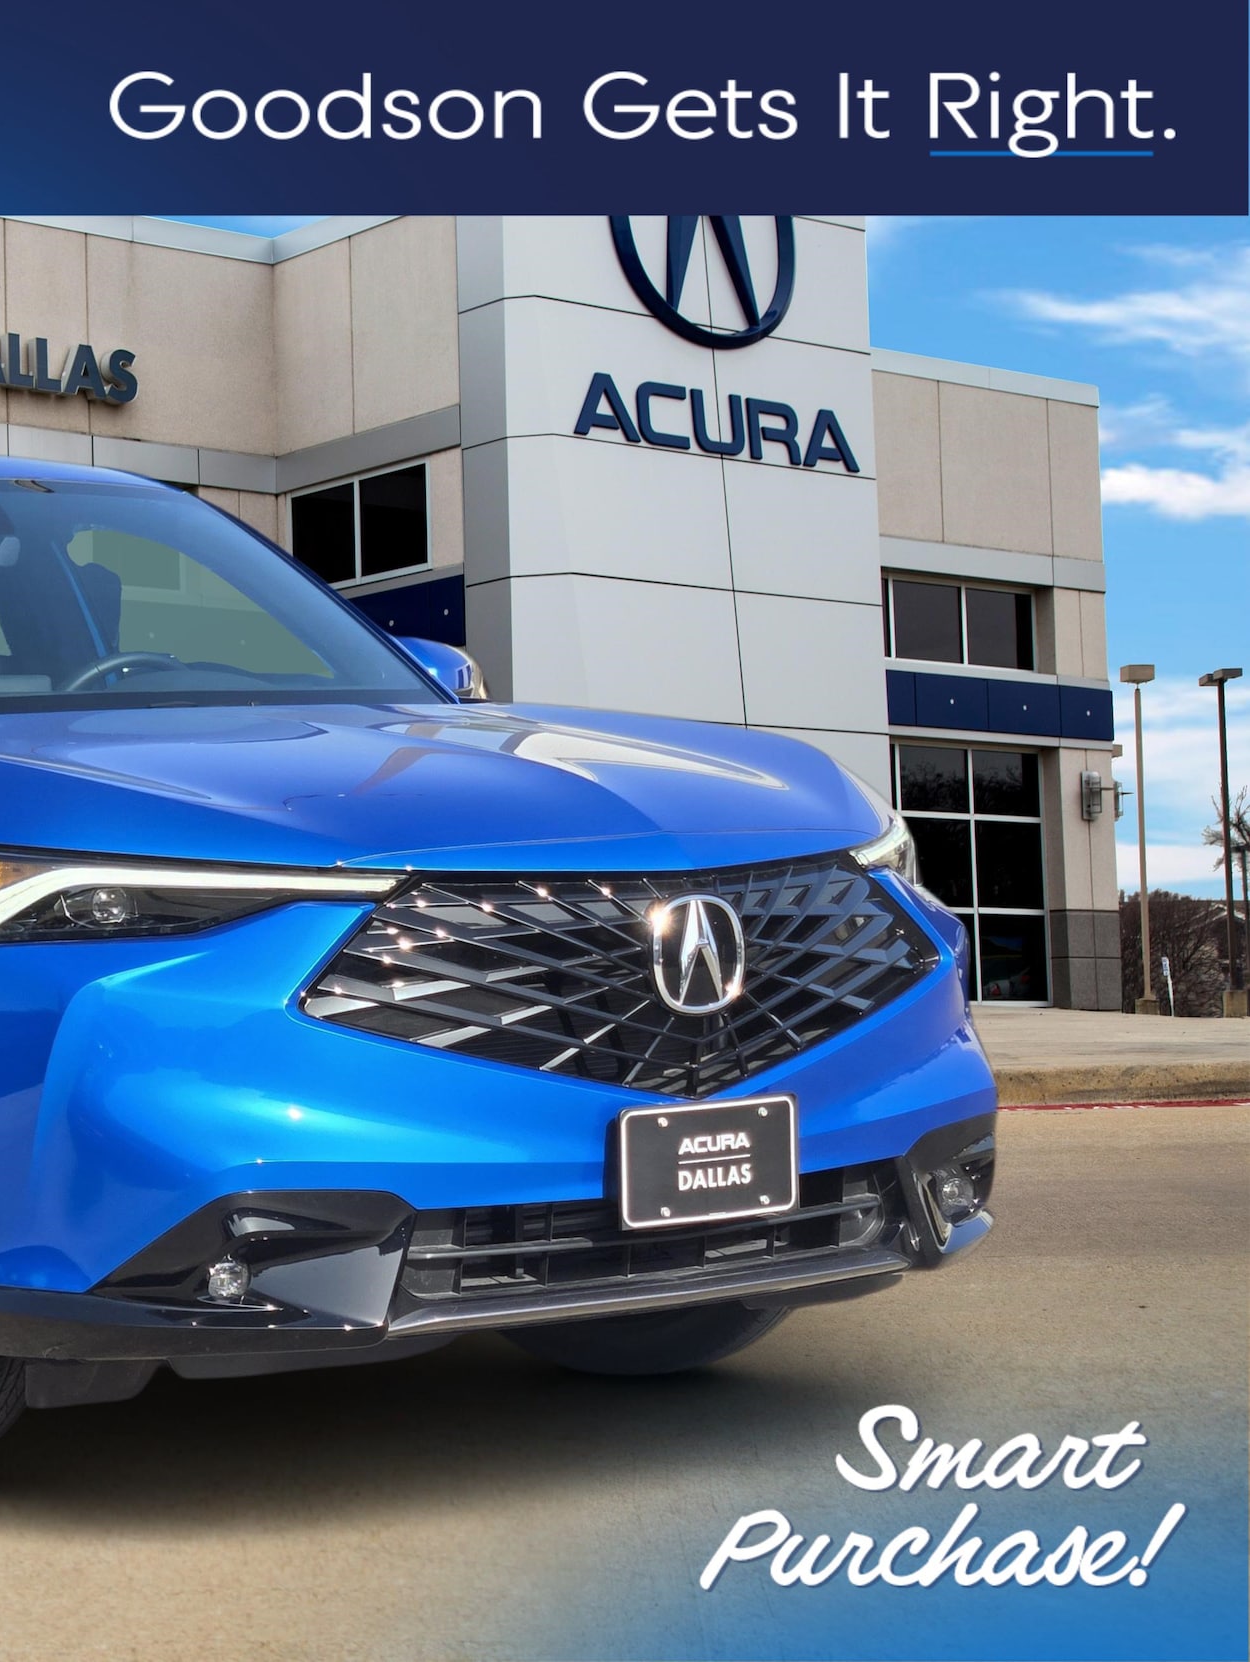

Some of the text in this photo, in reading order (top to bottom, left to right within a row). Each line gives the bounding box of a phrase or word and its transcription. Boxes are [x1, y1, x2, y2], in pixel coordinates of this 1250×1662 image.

[573, 371, 861, 474] ACURA
[678, 1132, 751, 1156] ACURA
[678, 1163, 752, 1192] DALLAS
